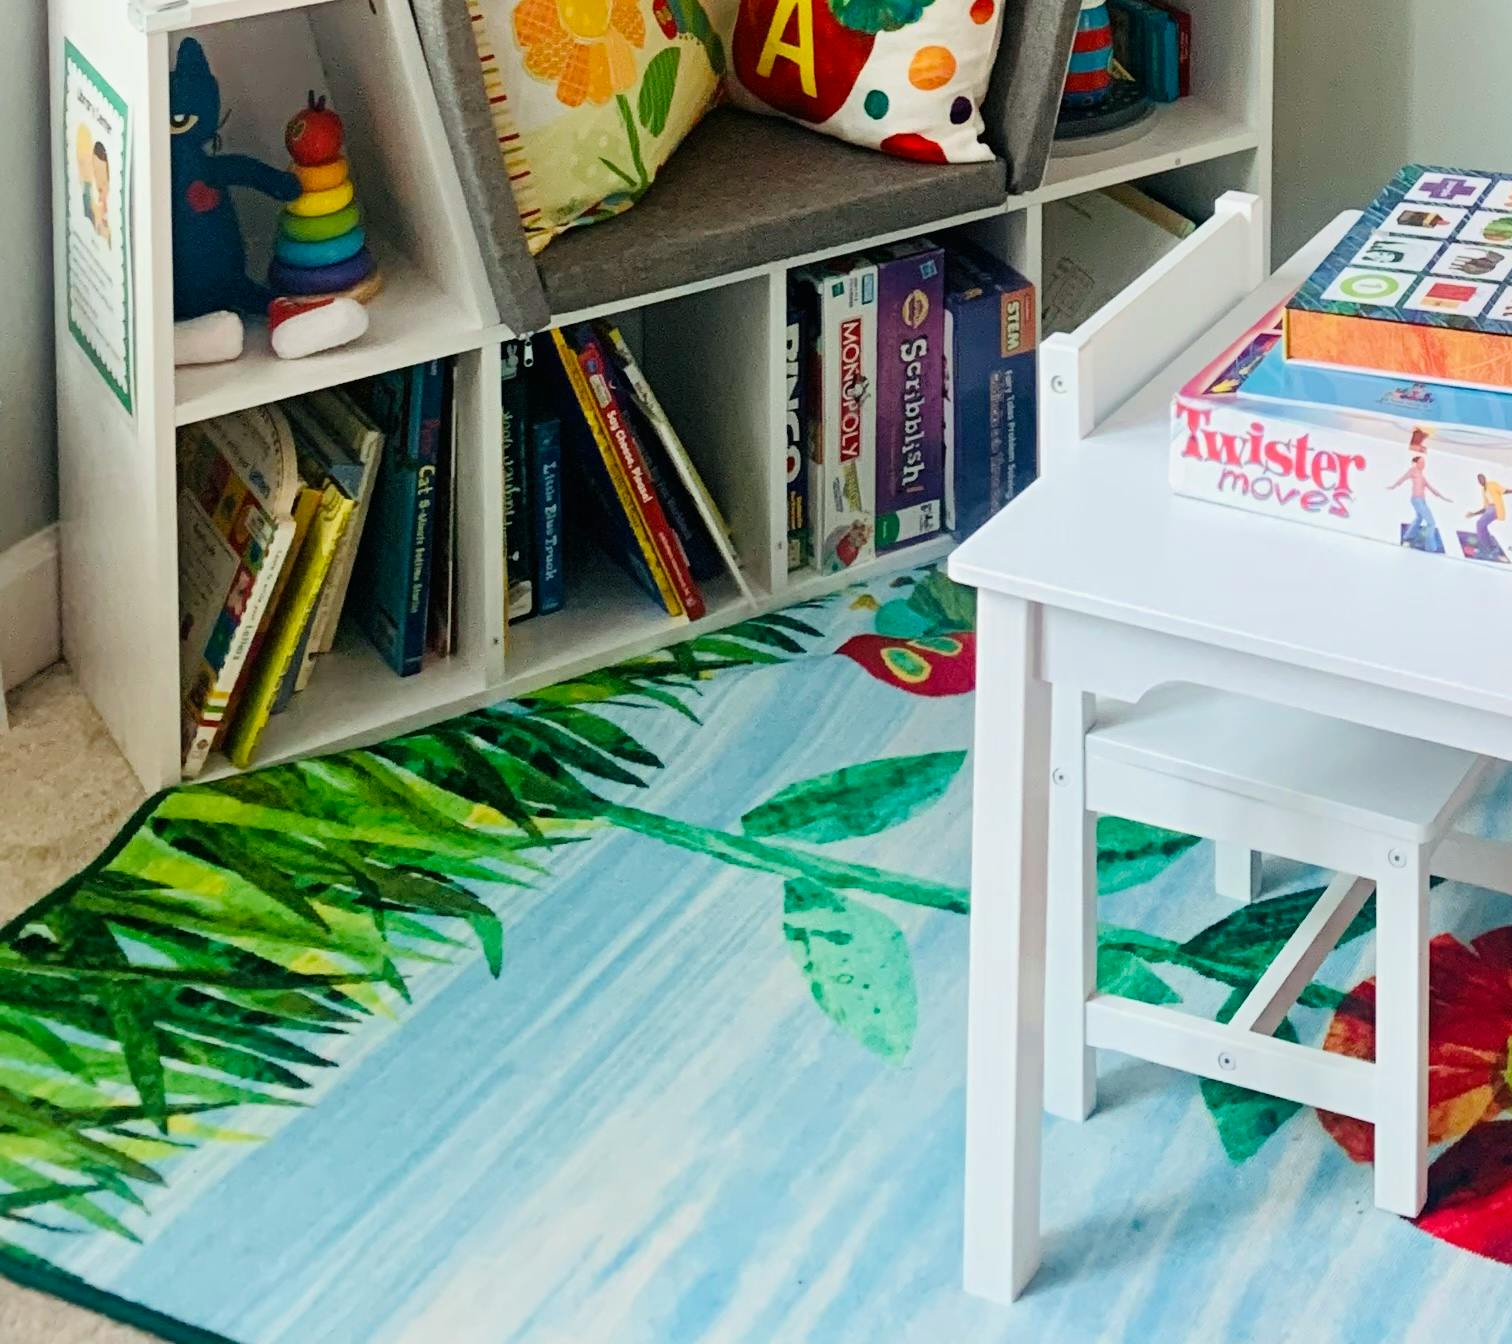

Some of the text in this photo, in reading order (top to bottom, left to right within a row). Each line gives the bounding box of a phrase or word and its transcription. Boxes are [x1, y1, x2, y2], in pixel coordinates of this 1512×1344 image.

[1006, 299, 1020, 351] STEM
[842, 321, 860, 458] MONOPOLY
[1007, 394, 1015, 415] Tales
[607, 409, 653, 503] Say Cheese, Please!
[1007, 417, 1016, 462] Problem
[1176, 400, 1366, 493] Twister
[417, 464, 436, 496] Cat
[1005, 463, 1014, 500] Solving
[1217, 467, 1358, 519] moves
[542, 461, 558, 582] Little Blue Truck
